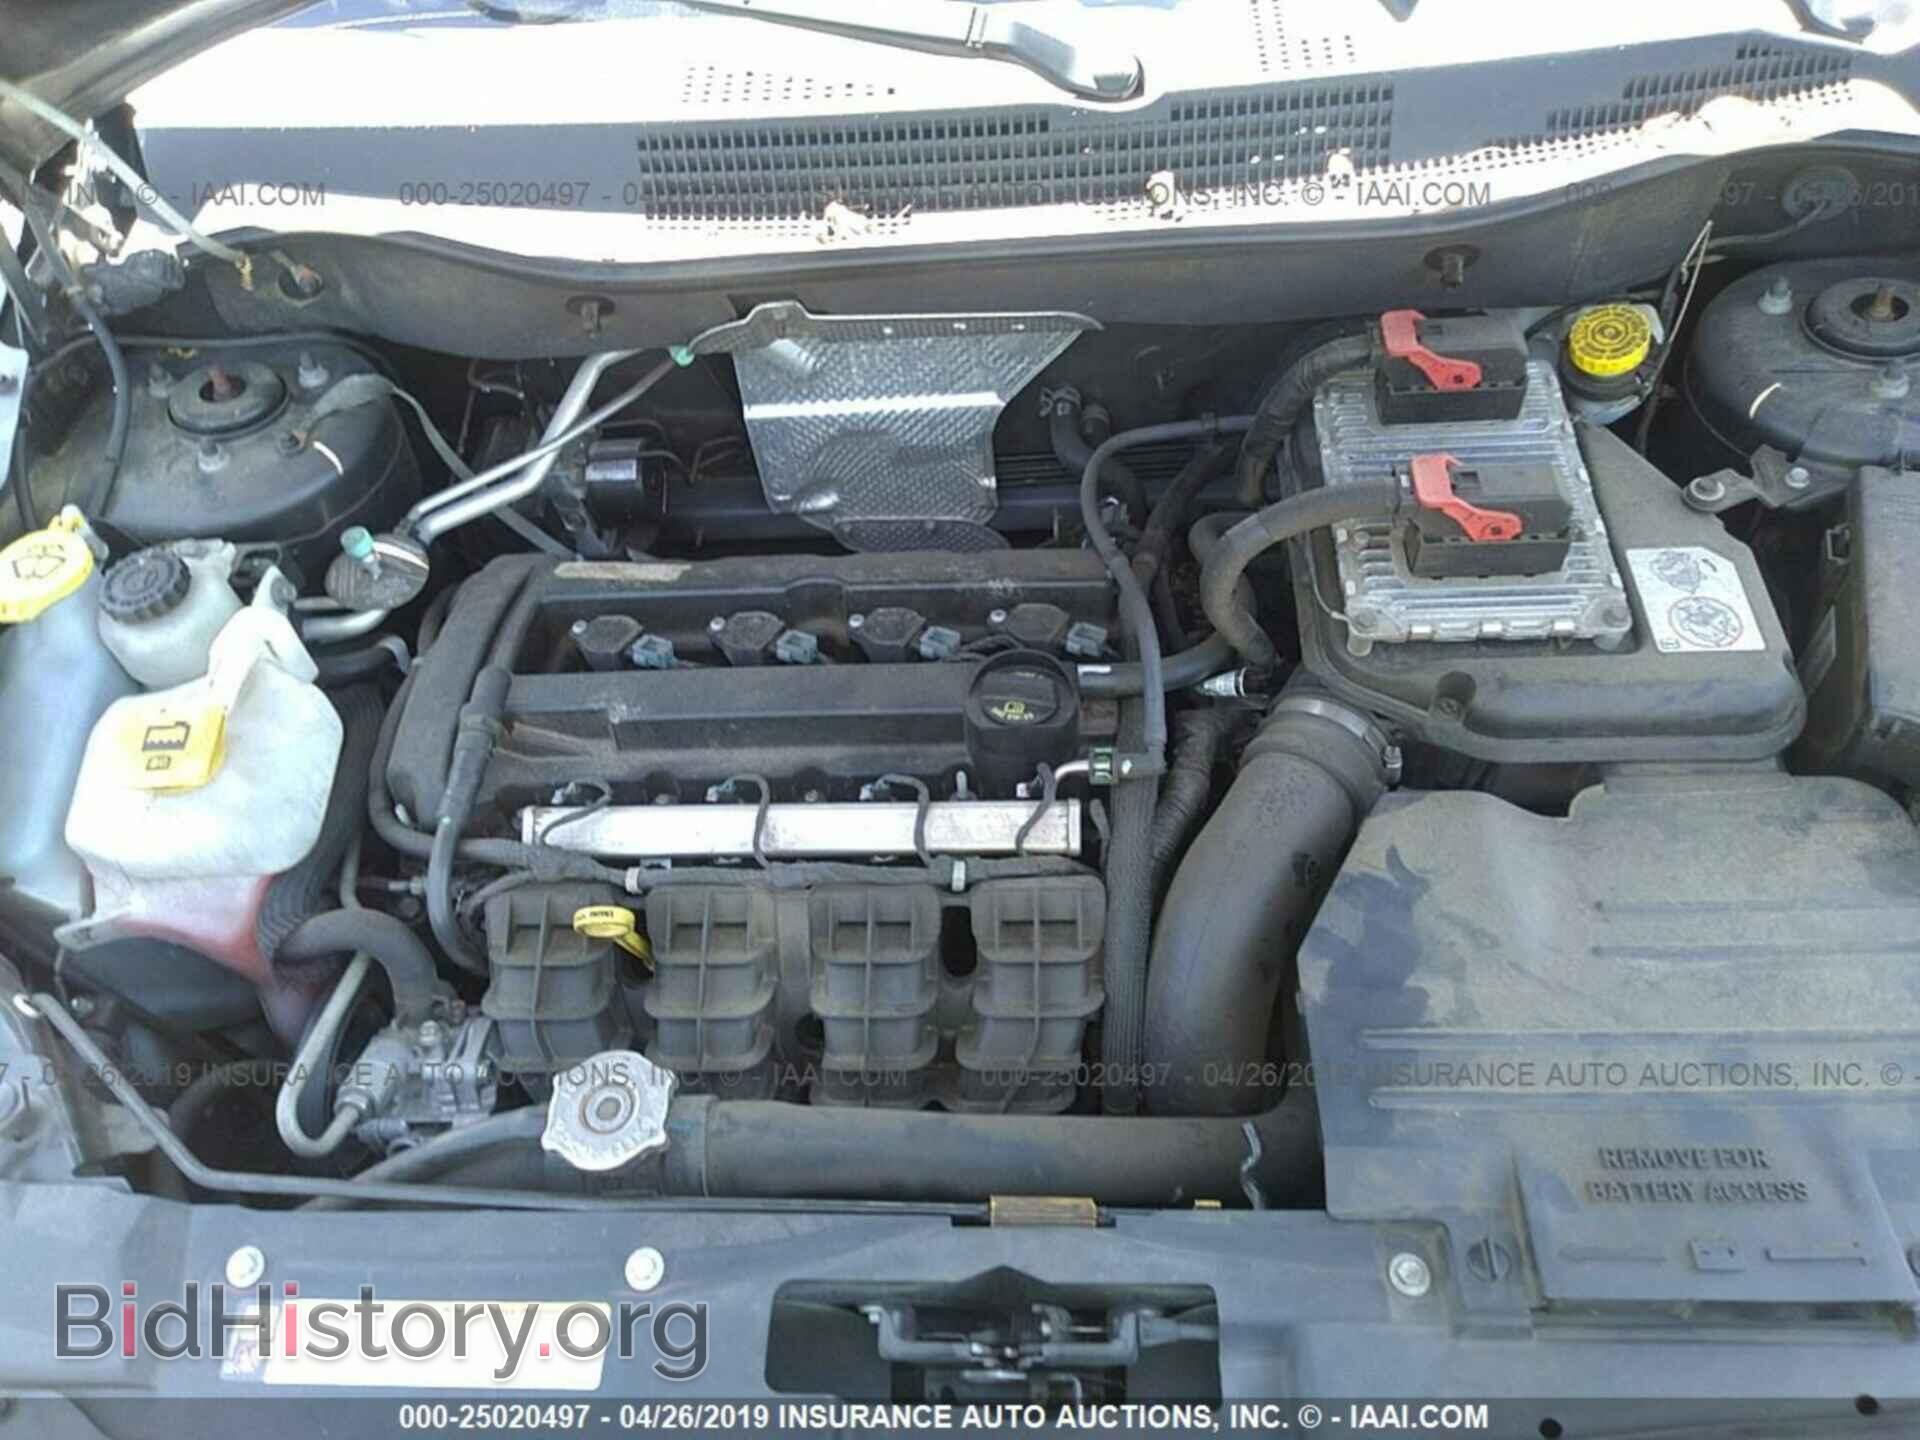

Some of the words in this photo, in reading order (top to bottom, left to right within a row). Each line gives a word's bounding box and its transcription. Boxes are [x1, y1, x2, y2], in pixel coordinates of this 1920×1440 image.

[1599, 1147, 1708, 1170] REMOVE
[1712, 1147, 1771, 1170] FOR
[1586, 1180, 1695, 1203] BATTERY
[1705, 1180, 1809, 1203] ACCESS
